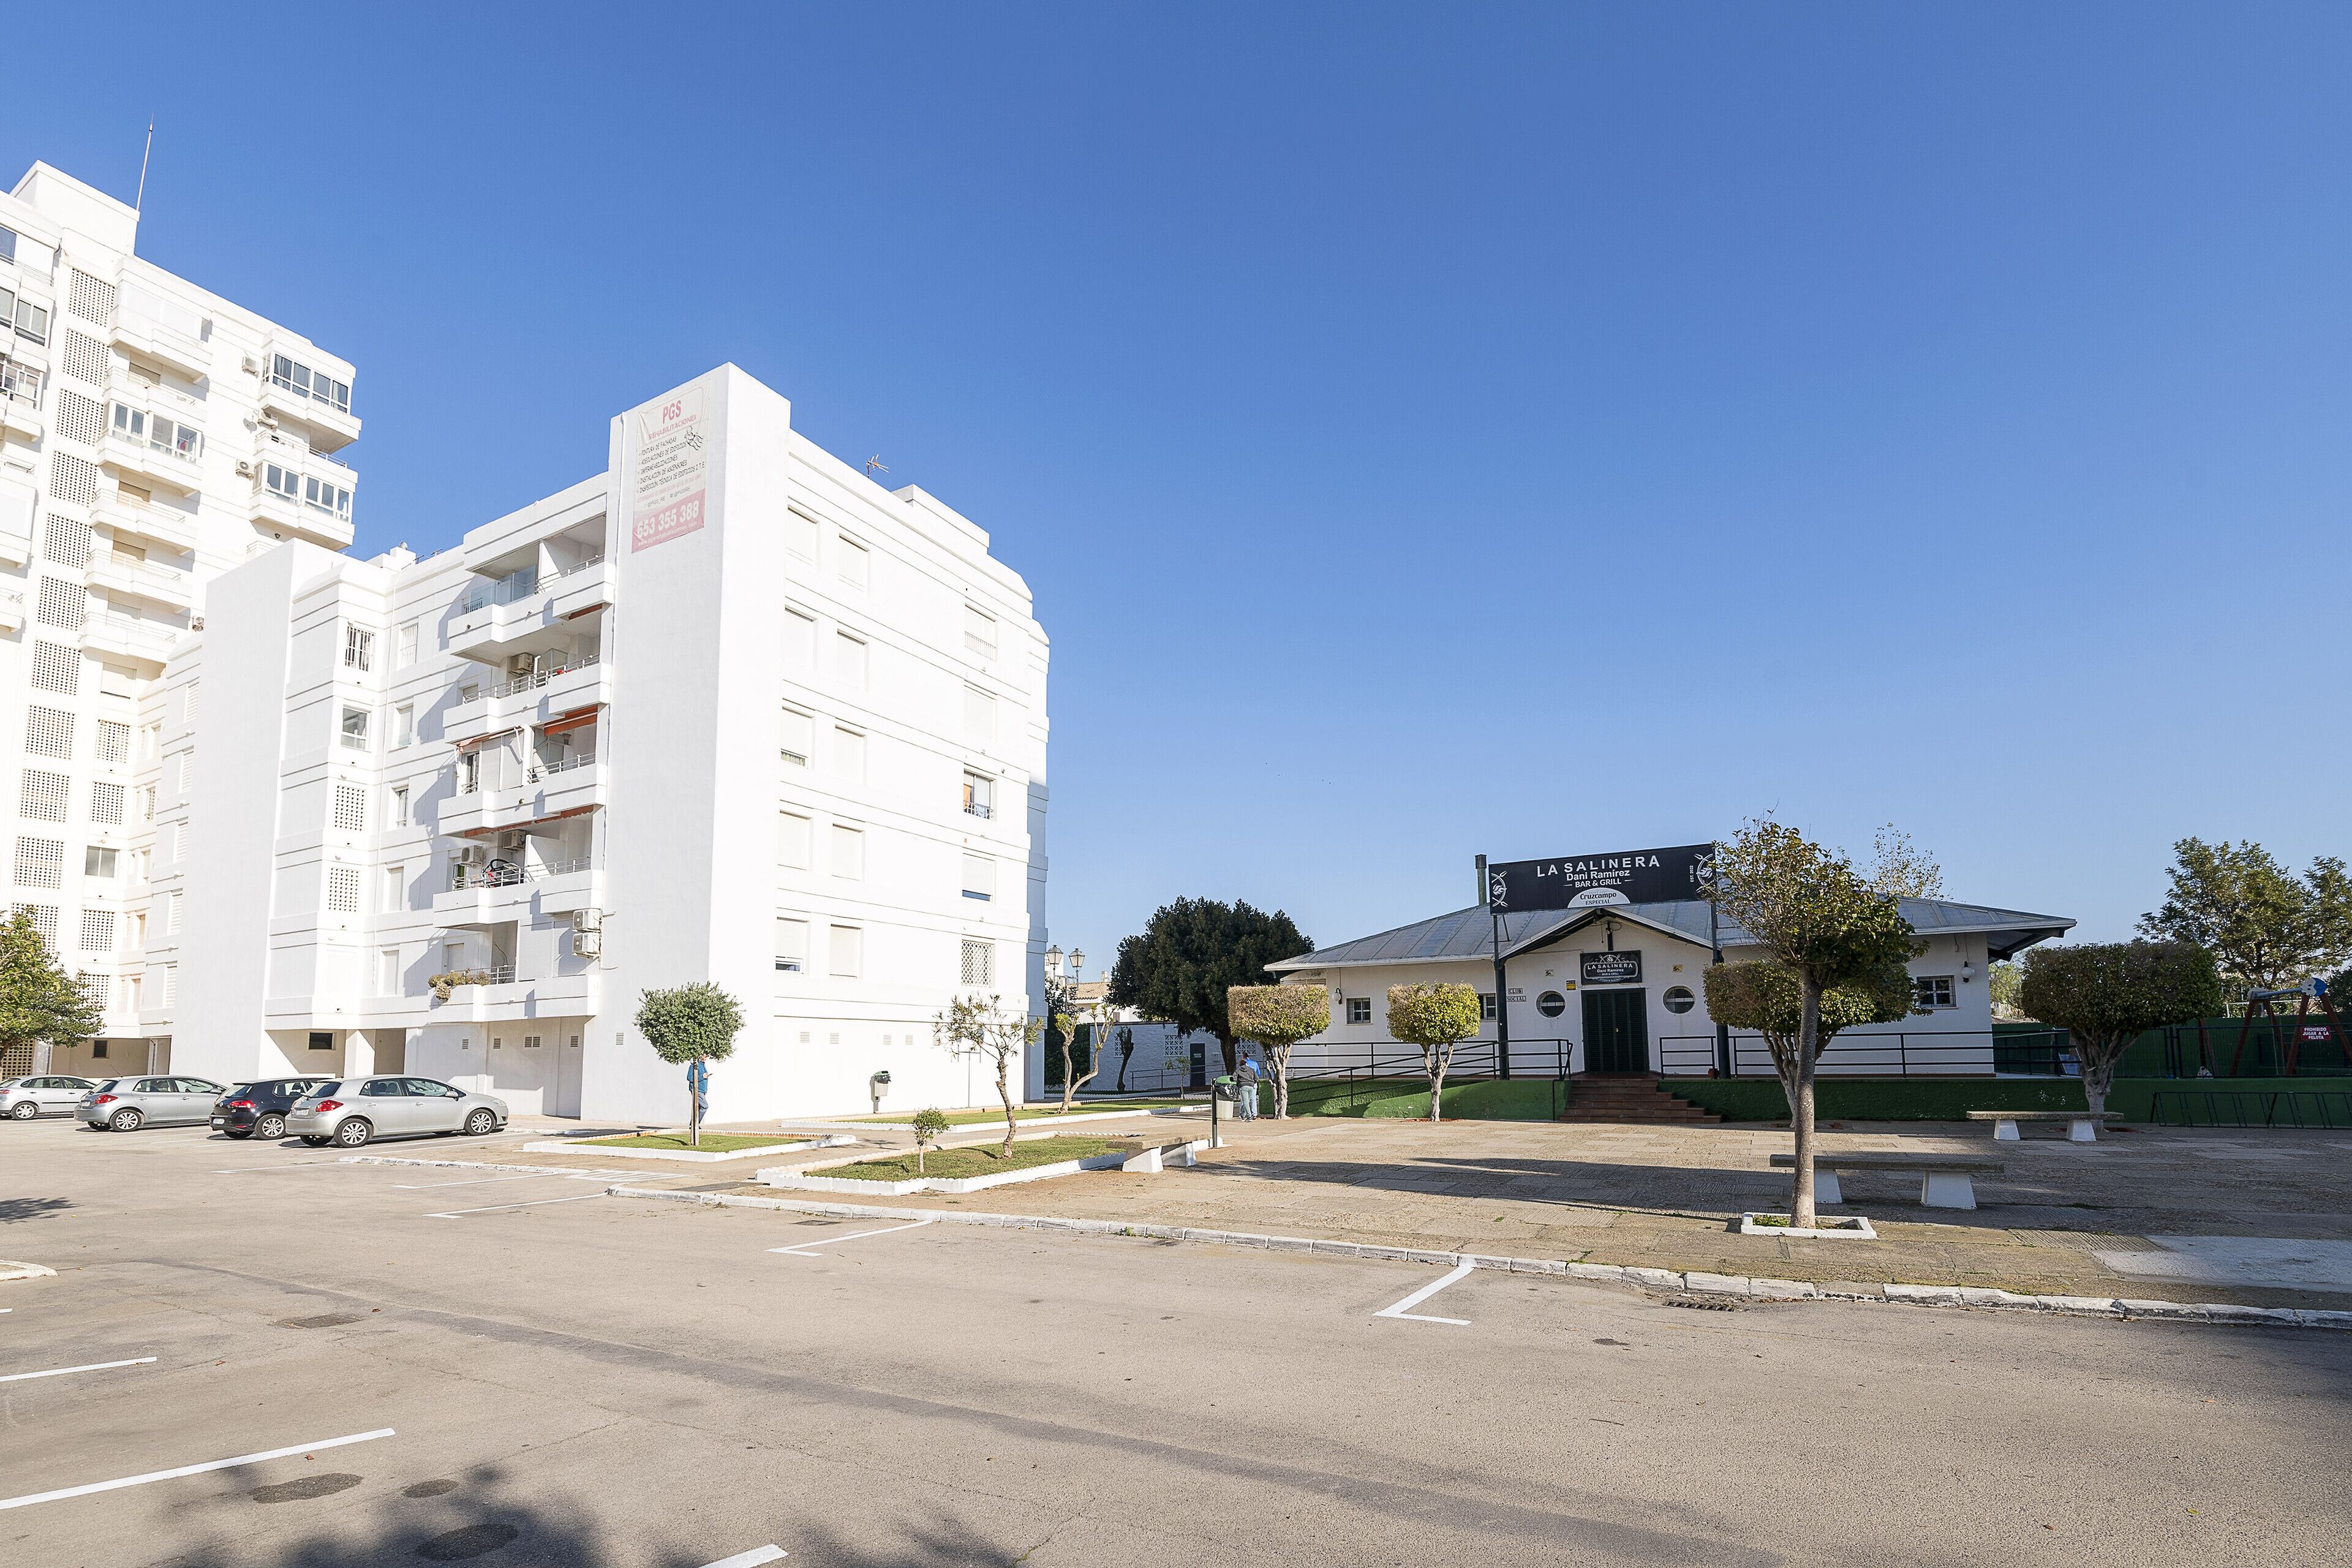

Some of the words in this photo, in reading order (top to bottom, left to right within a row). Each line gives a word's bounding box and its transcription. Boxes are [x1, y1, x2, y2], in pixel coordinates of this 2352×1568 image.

[662, 399, 681, 424] PGS
[648, 414, 696, 440] REHABILITACIONES
[637, 517, 655, 539] 653
[658, 508, 677, 531] 355
[680, 500, 699, 523] 388
[1537, 864, 1558, 877] LA
[1564, 855, 1660, 873] SALINERA
[1566, 872, 1588, 881] Dani
[1591, 869, 1630, 879] Ramírez
